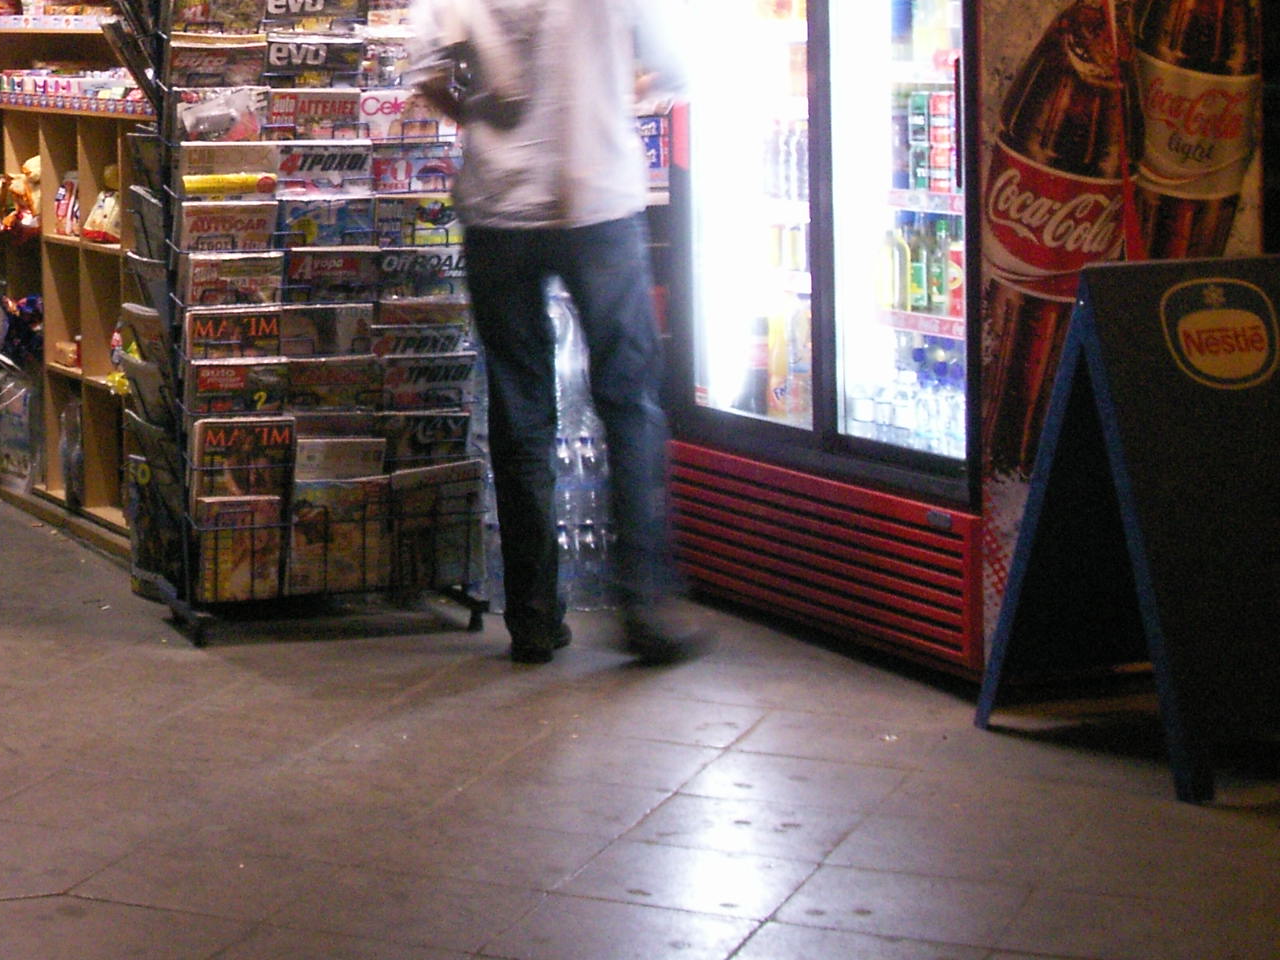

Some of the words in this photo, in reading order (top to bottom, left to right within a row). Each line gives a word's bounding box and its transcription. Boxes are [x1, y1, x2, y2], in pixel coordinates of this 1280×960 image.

[269, 43, 328, 66] evo
[988, 167, 1123, 253] Coca-Cola
[188, 216, 267, 234] AUTOCAR
[194, 316, 280, 337] MAIM
[205, 427, 291, 446] MAIM
